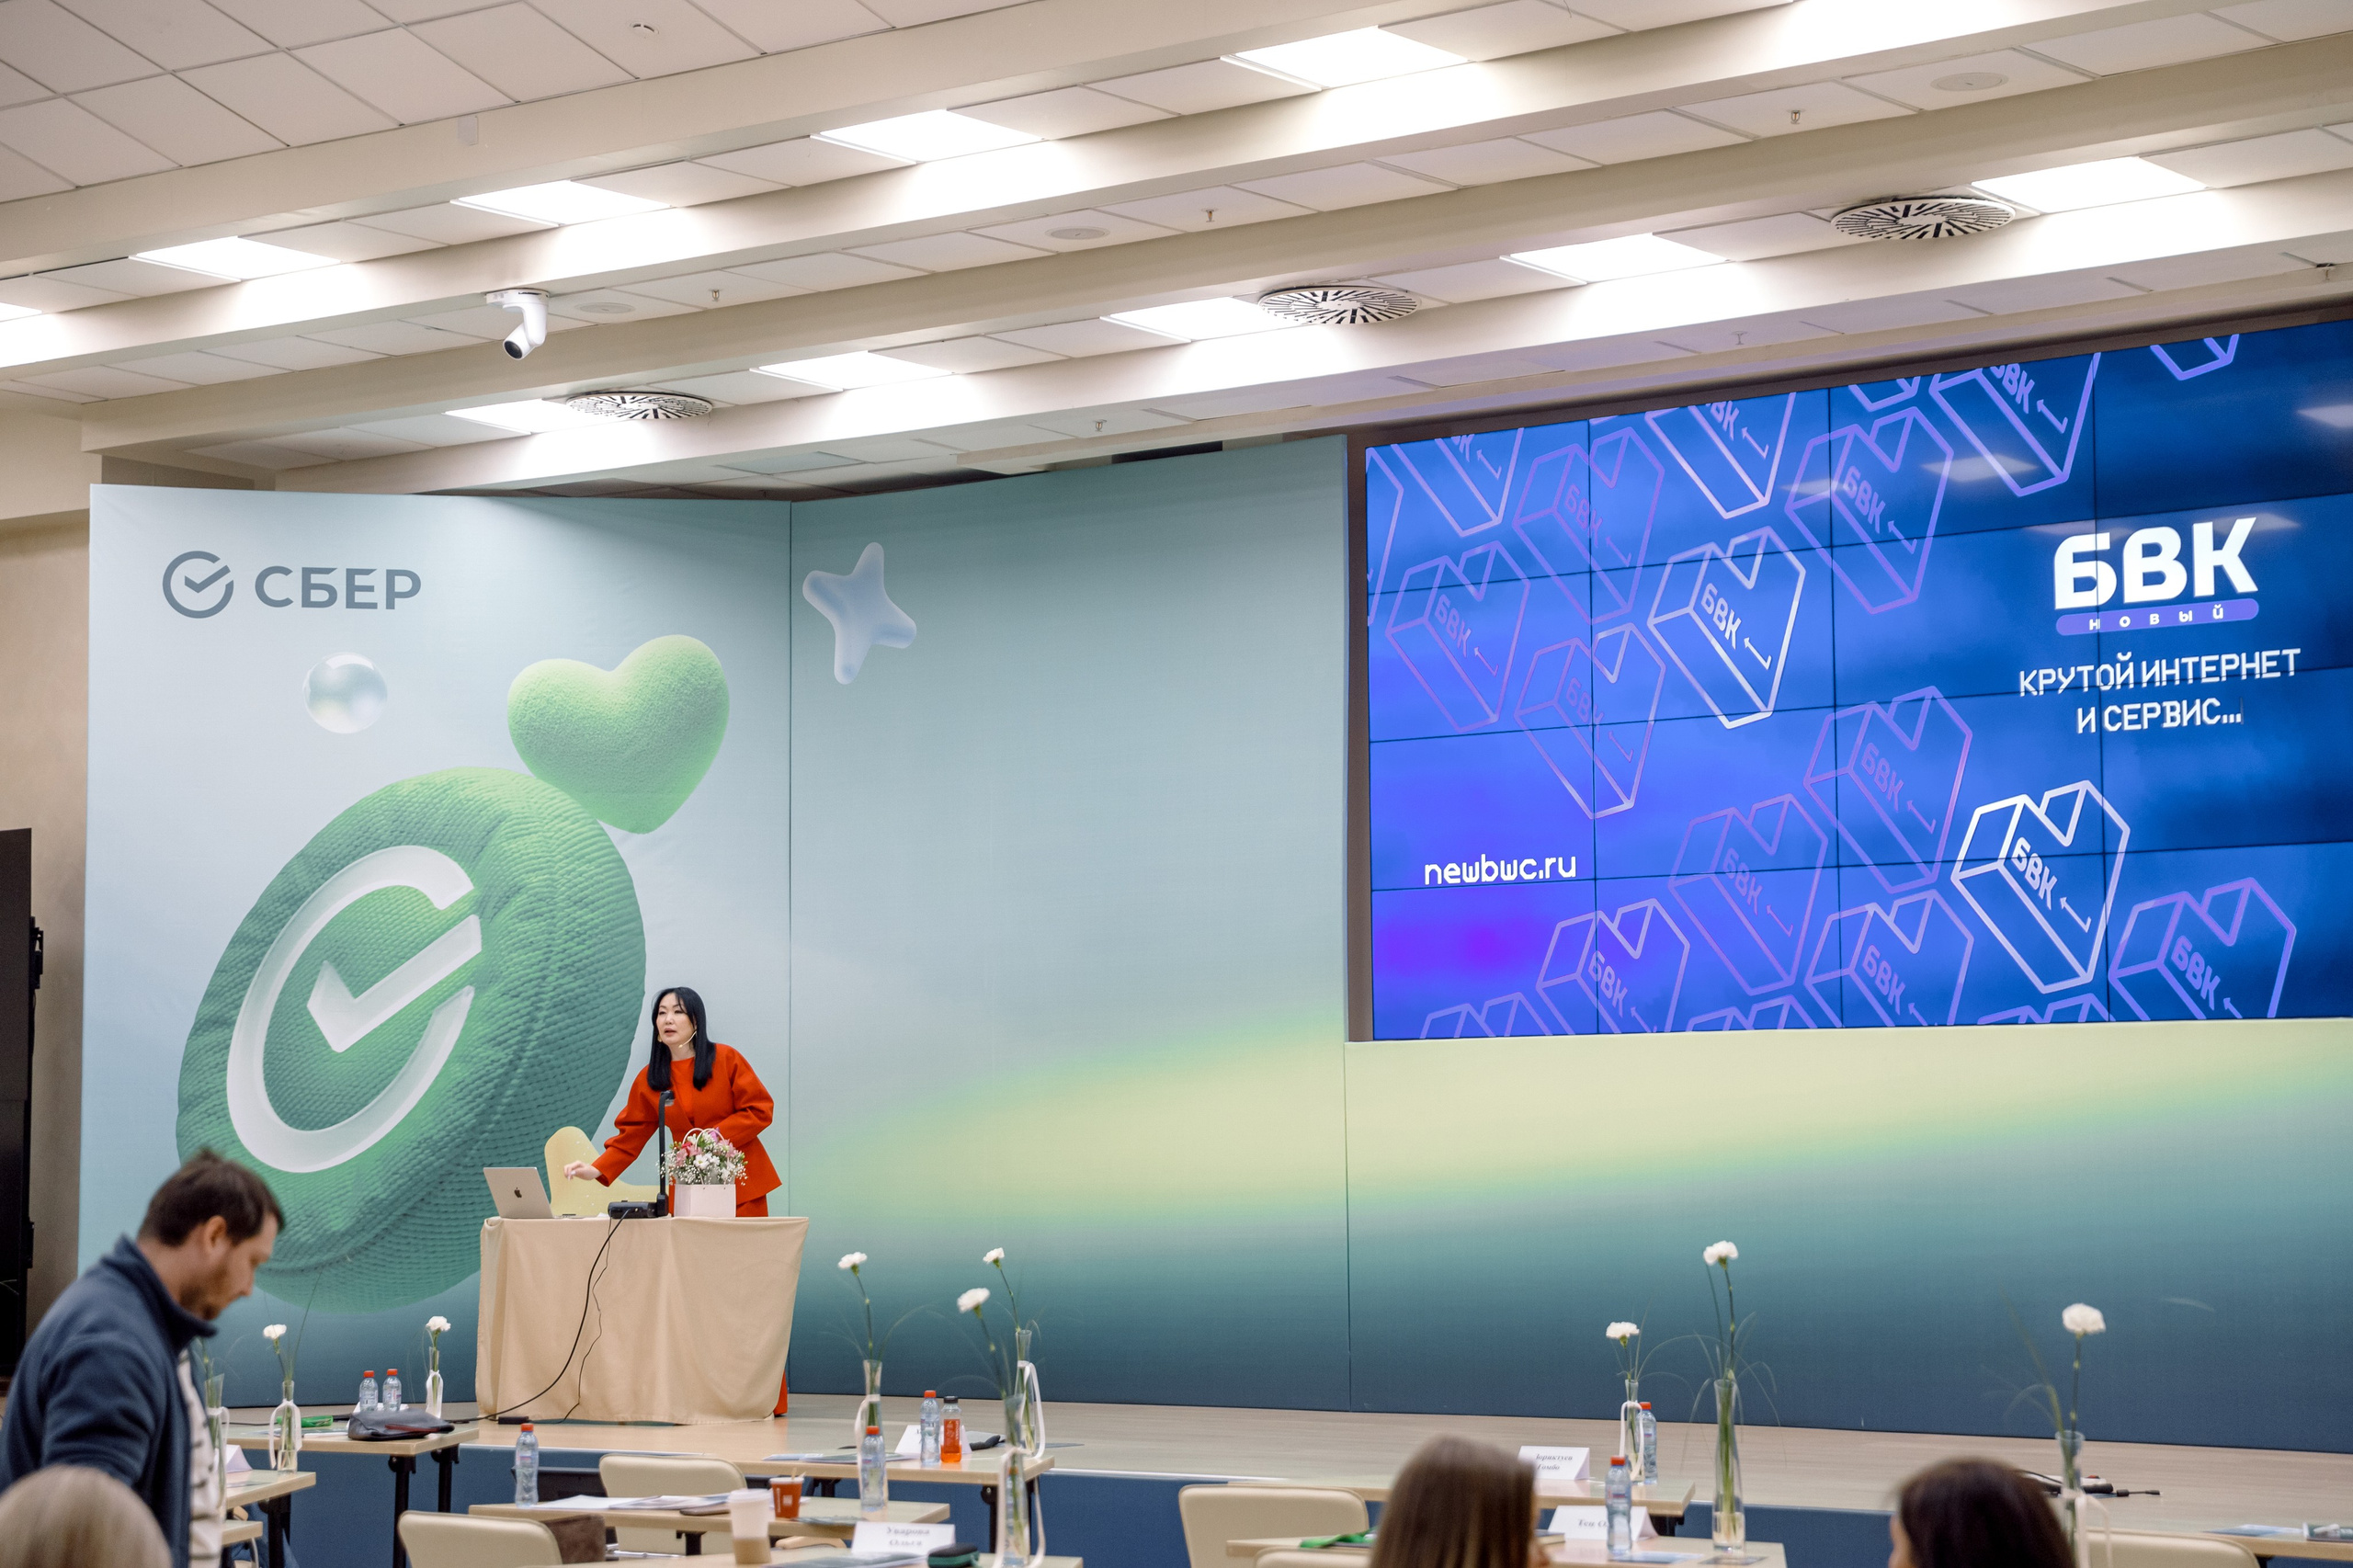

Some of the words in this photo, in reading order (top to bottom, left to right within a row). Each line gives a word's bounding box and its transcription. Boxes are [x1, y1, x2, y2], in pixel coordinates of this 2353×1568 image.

[1706, 401, 1740, 441] ВК
[1565, 484, 1603, 548] БВК
[1842, 466, 1885, 534] БВК
[255, 565, 422, 609] СБЕР
[2054, 517, 2258, 610] БВК
[1434, 594, 1472, 658] БВК
[1700, 583, 1742, 650] БВК
[2018, 651, 2135, 698] КРУТОЙ
[2141, 648, 2302, 688] ИНТЕРНЕТ
[1565, 677, 1604, 742] БВК
[2076, 708, 2097, 734] И
[2103, 698, 2243, 733] СЕРВИС...
[1860, 743, 1904, 812] БВК
[1424, 853, 1577, 885] newbwc.ru
[1722, 847, 1764, 916] БВК
[2011, 836, 2058, 911] БВК
[1587, 949, 1628, 1018] БВК
[1861, 944, 1905, 1016] БВК
[2171, 935, 2222, 1011] БВК
